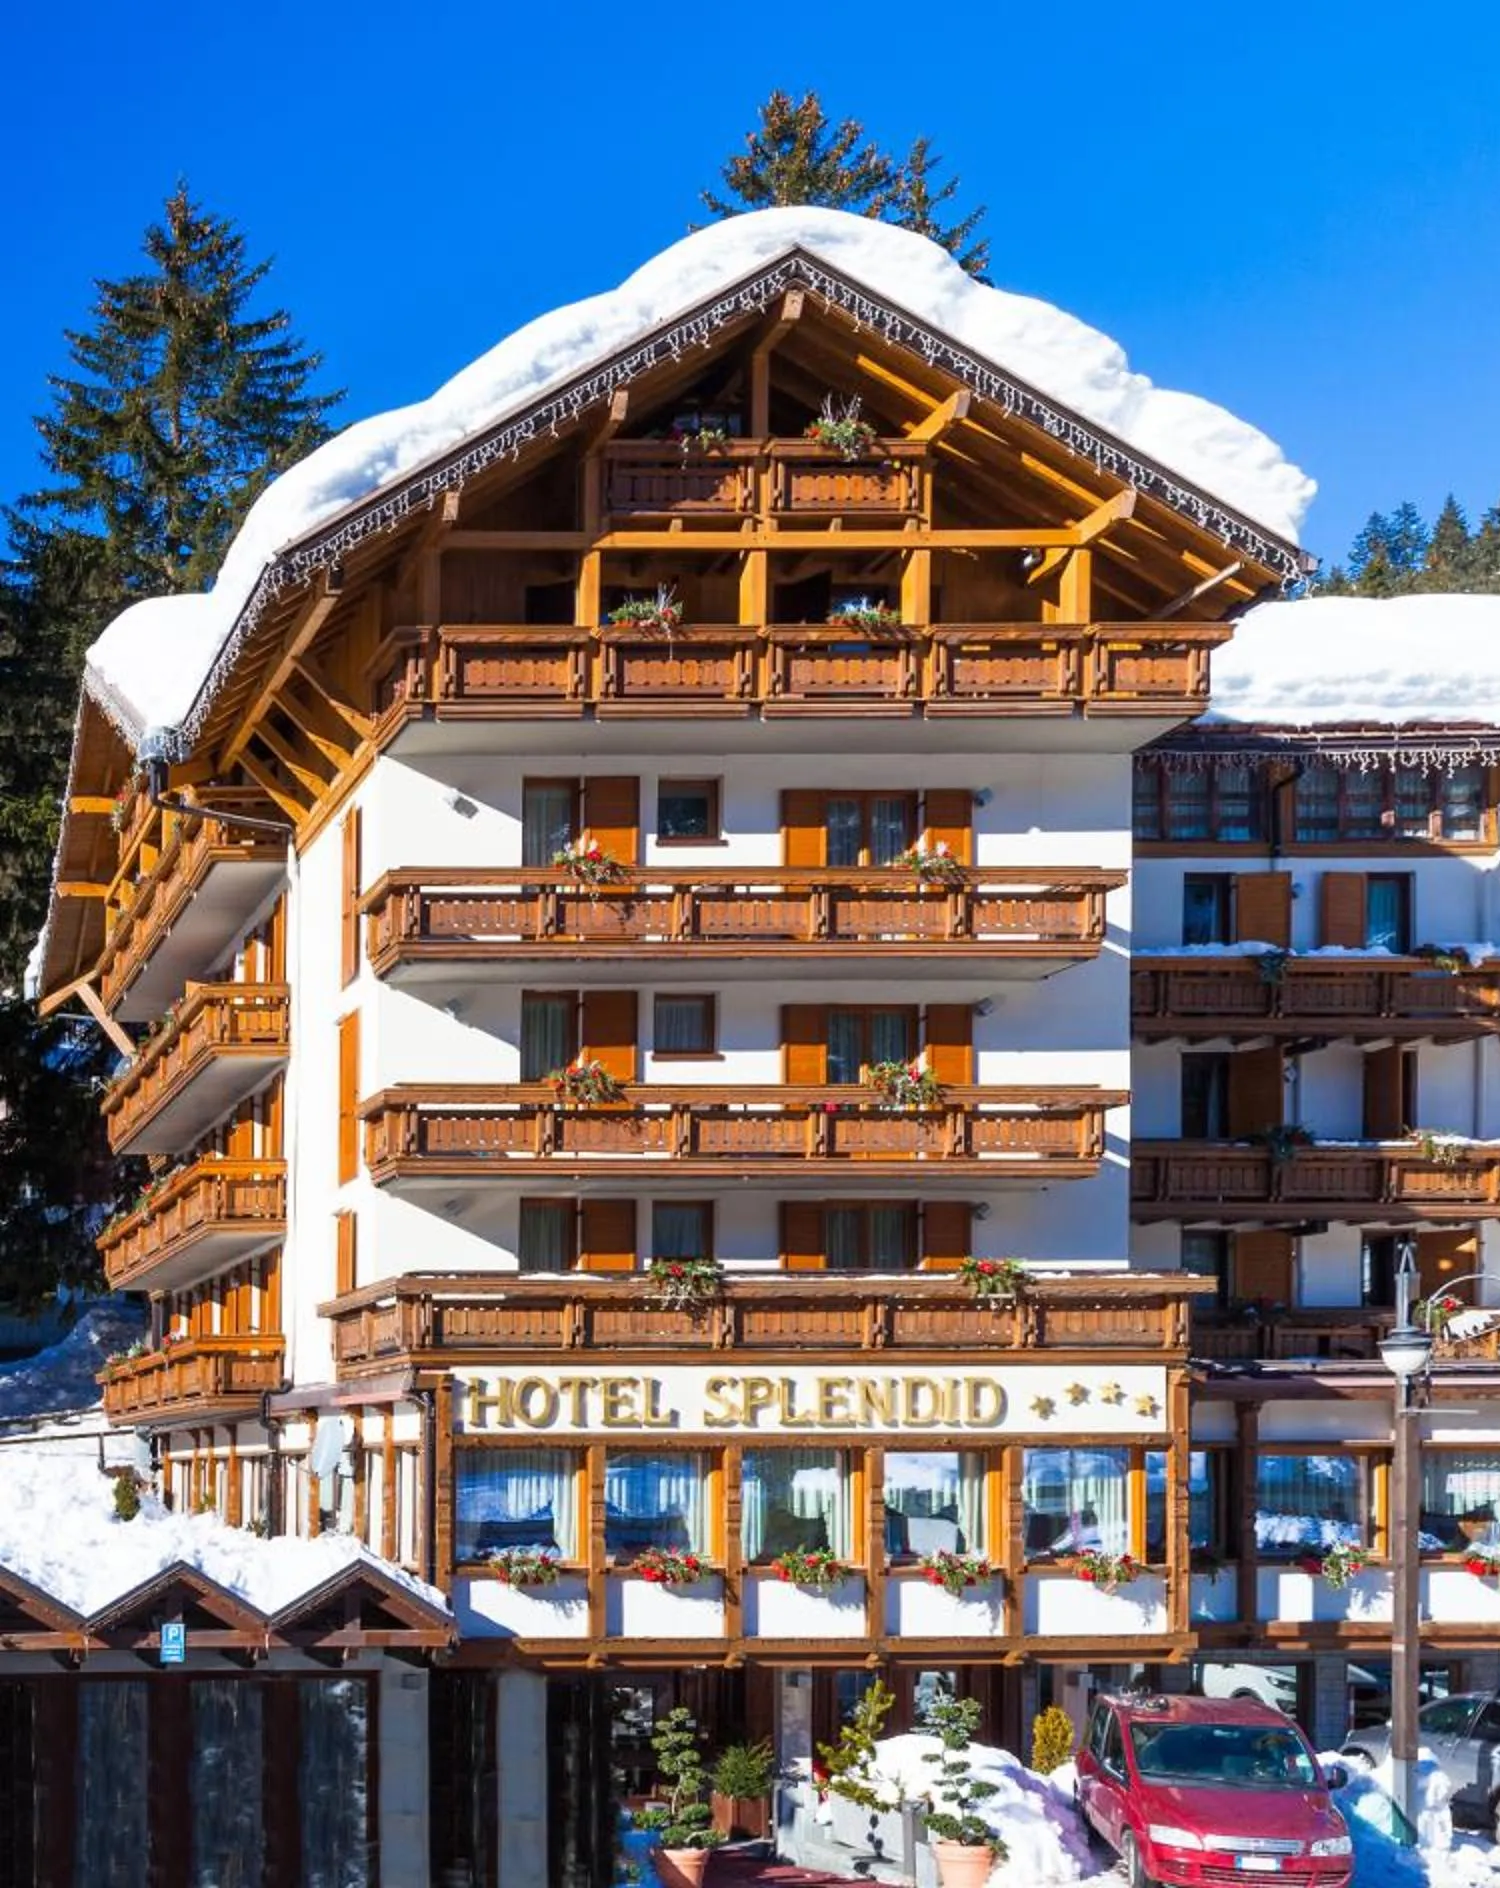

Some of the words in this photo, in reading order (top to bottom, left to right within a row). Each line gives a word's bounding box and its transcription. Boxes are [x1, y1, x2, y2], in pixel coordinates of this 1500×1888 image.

[467, 1376, 679, 1427] HOTEL
[704, 1376, 1007, 1427] SPLENDID
[168, 1627, 178, 1640] P
